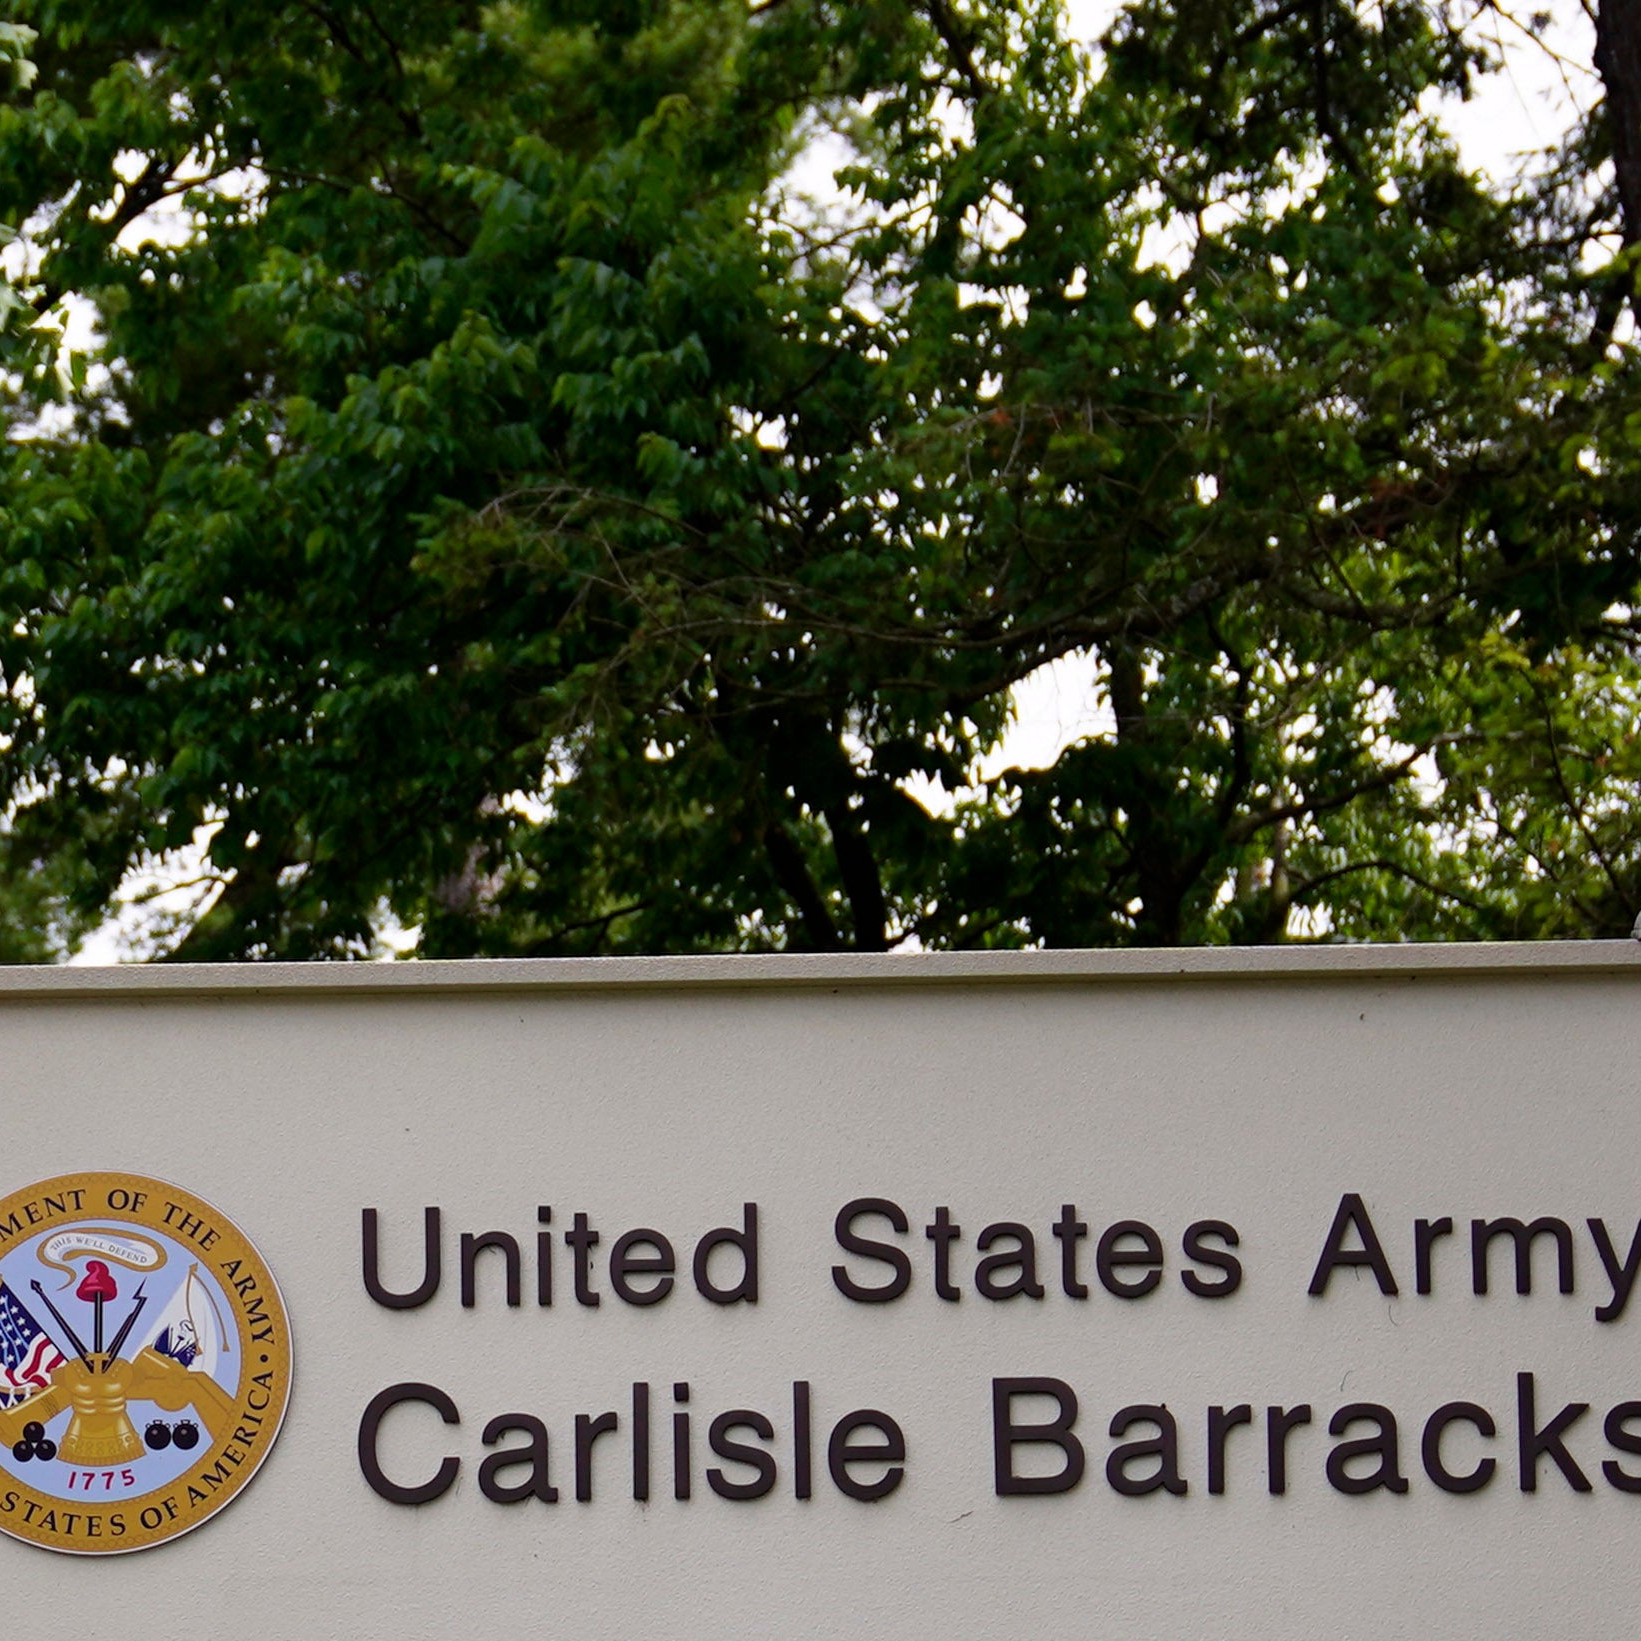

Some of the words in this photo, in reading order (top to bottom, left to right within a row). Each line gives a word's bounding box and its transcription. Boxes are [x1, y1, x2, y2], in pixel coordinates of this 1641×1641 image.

[50, 1235, 72, 1251] THIS
[108, 1244, 148, 1264] DEFEND
[106, 1187, 148, 1211] OF
[163, 1200, 221, 1252] THE
[220, 1258, 276, 1346] ARMY
[360, 1201, 760, 1313] United
[830, 1196, 1244, 1308] States
[0, 1490, 127, 1538] STATES
[139, 1496, 182, 1531] OF
[187, 1371, 275, 1509] AMERICA
[67, 1468, 136, 1491] 1775
[356, 1379, 908, 1508] Carlisle
